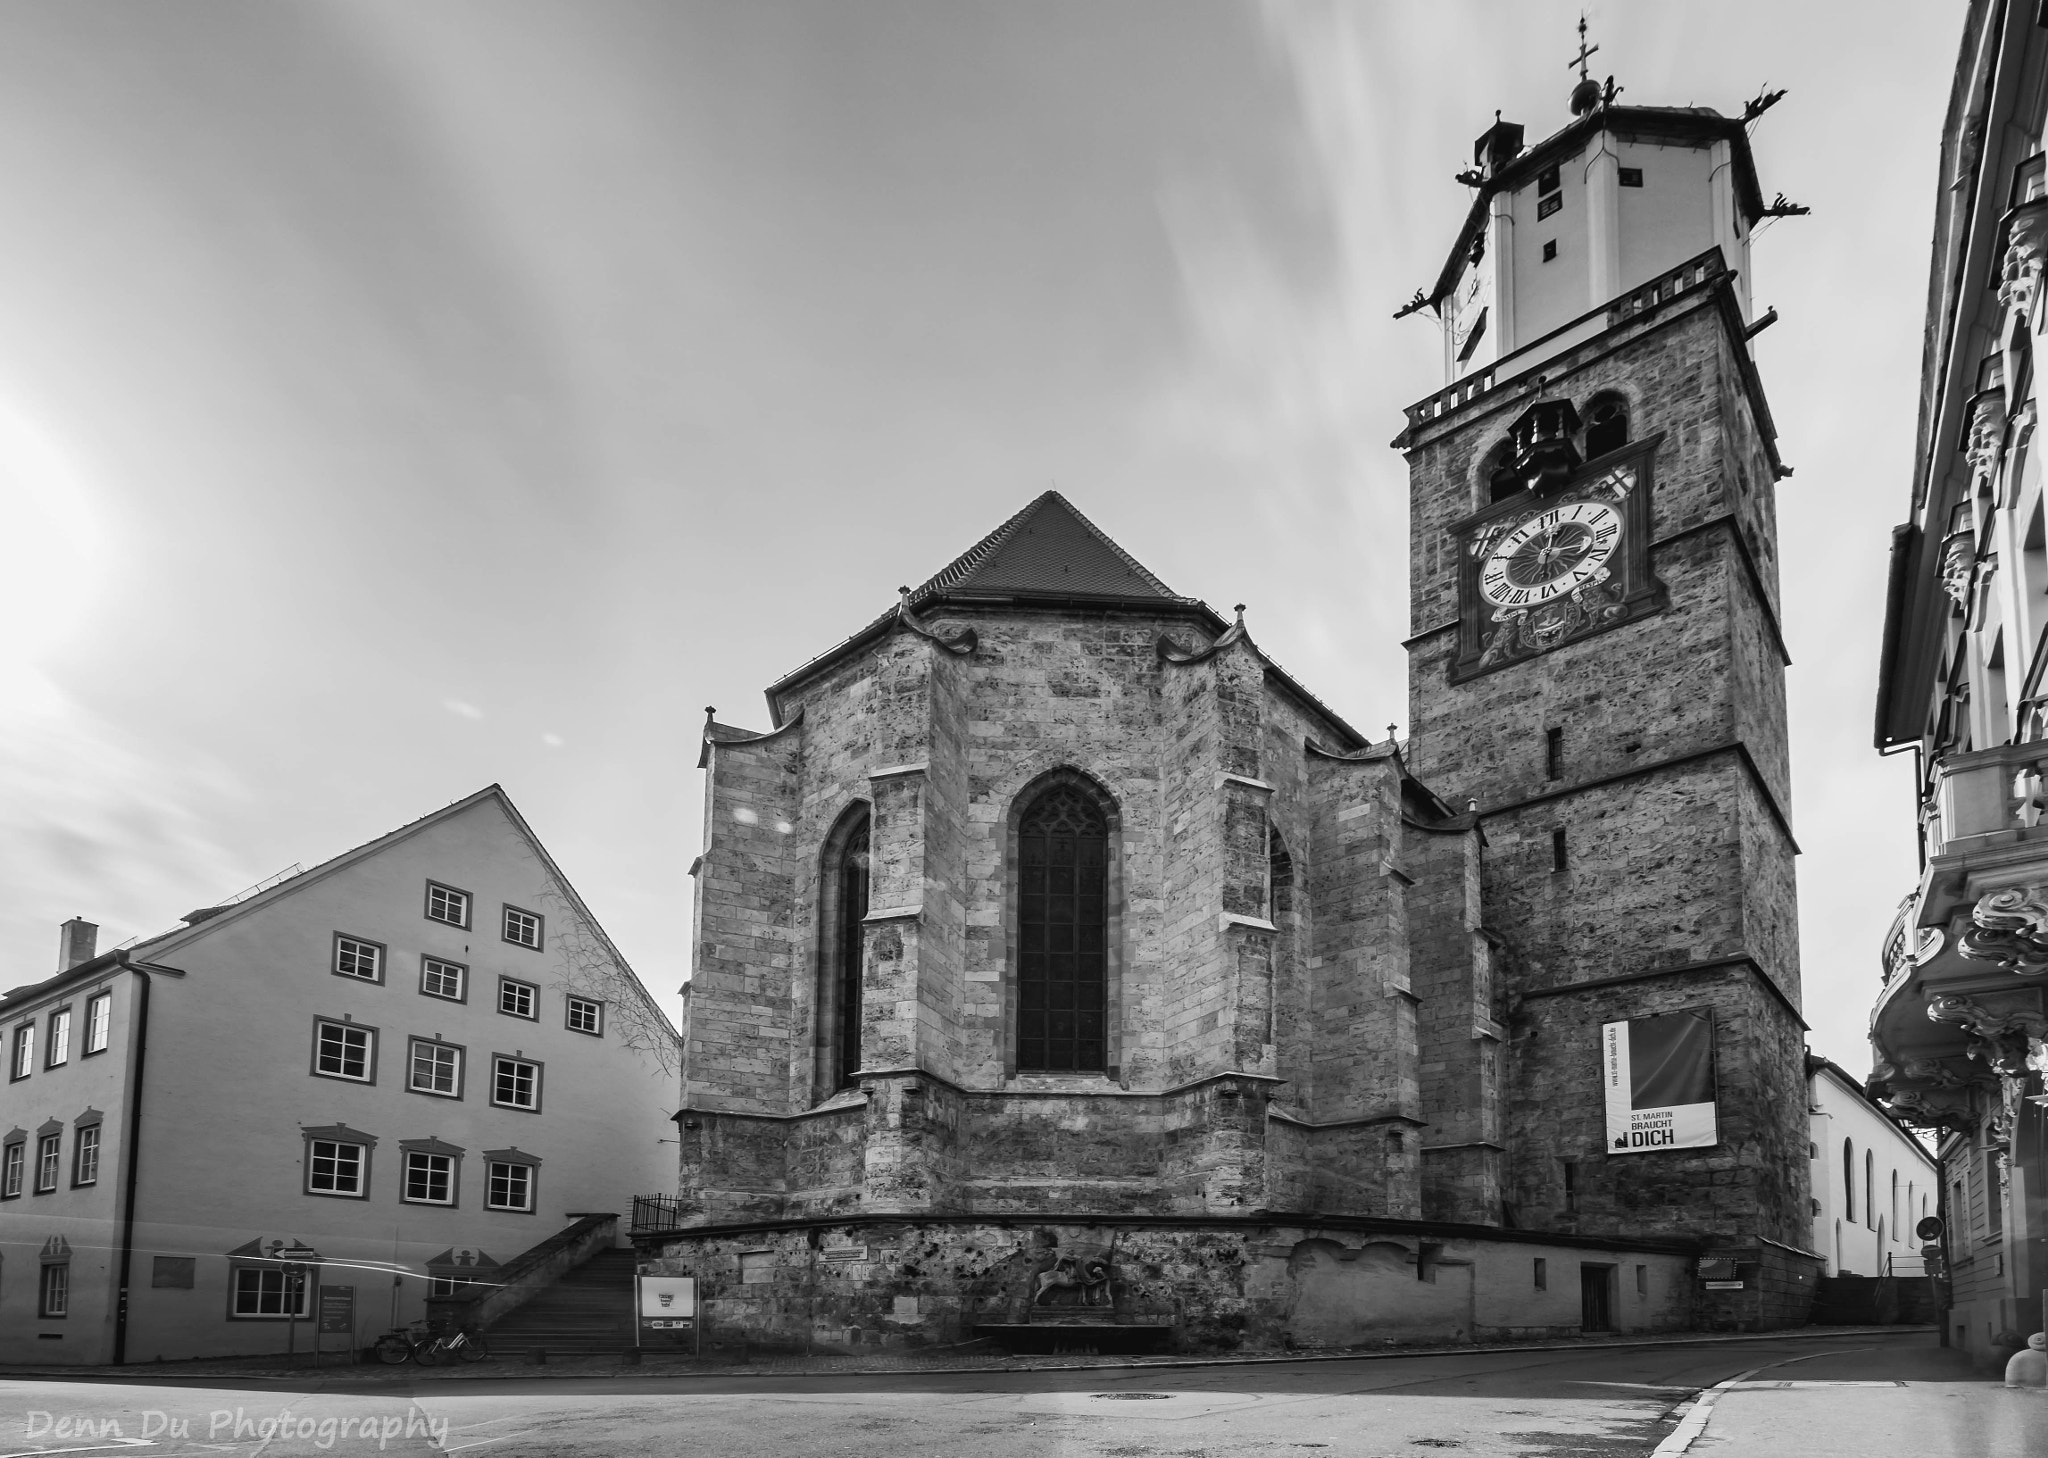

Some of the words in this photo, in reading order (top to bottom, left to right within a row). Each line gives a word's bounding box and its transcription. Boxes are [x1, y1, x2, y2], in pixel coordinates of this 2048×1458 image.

[1537, 509, 1559, 529] XII
[1571, 505, 1583, 520] I
[1588, 508, 1610, 525] II
[1510, 529, 1529, 544] XI
[1595, 523, 1618, 541] III
[1587, 546, 1611, 562] IV
[1484, 570, 1505, 585] IX
[1572, 570, 1589, 582] V
[1489, 582, 1513, 602] VIII
[1508, 589, 1531, 604] VII
[1541, 583, 1559, 599] VI
[1631, 1114, 1641, 1122] ST.
[1643, 1111, 1672, 1120] MARTIN
[1631, 1120, 1672, 1130] BRAUCHT
[1632, 1129, 1674, 1147] DICH
